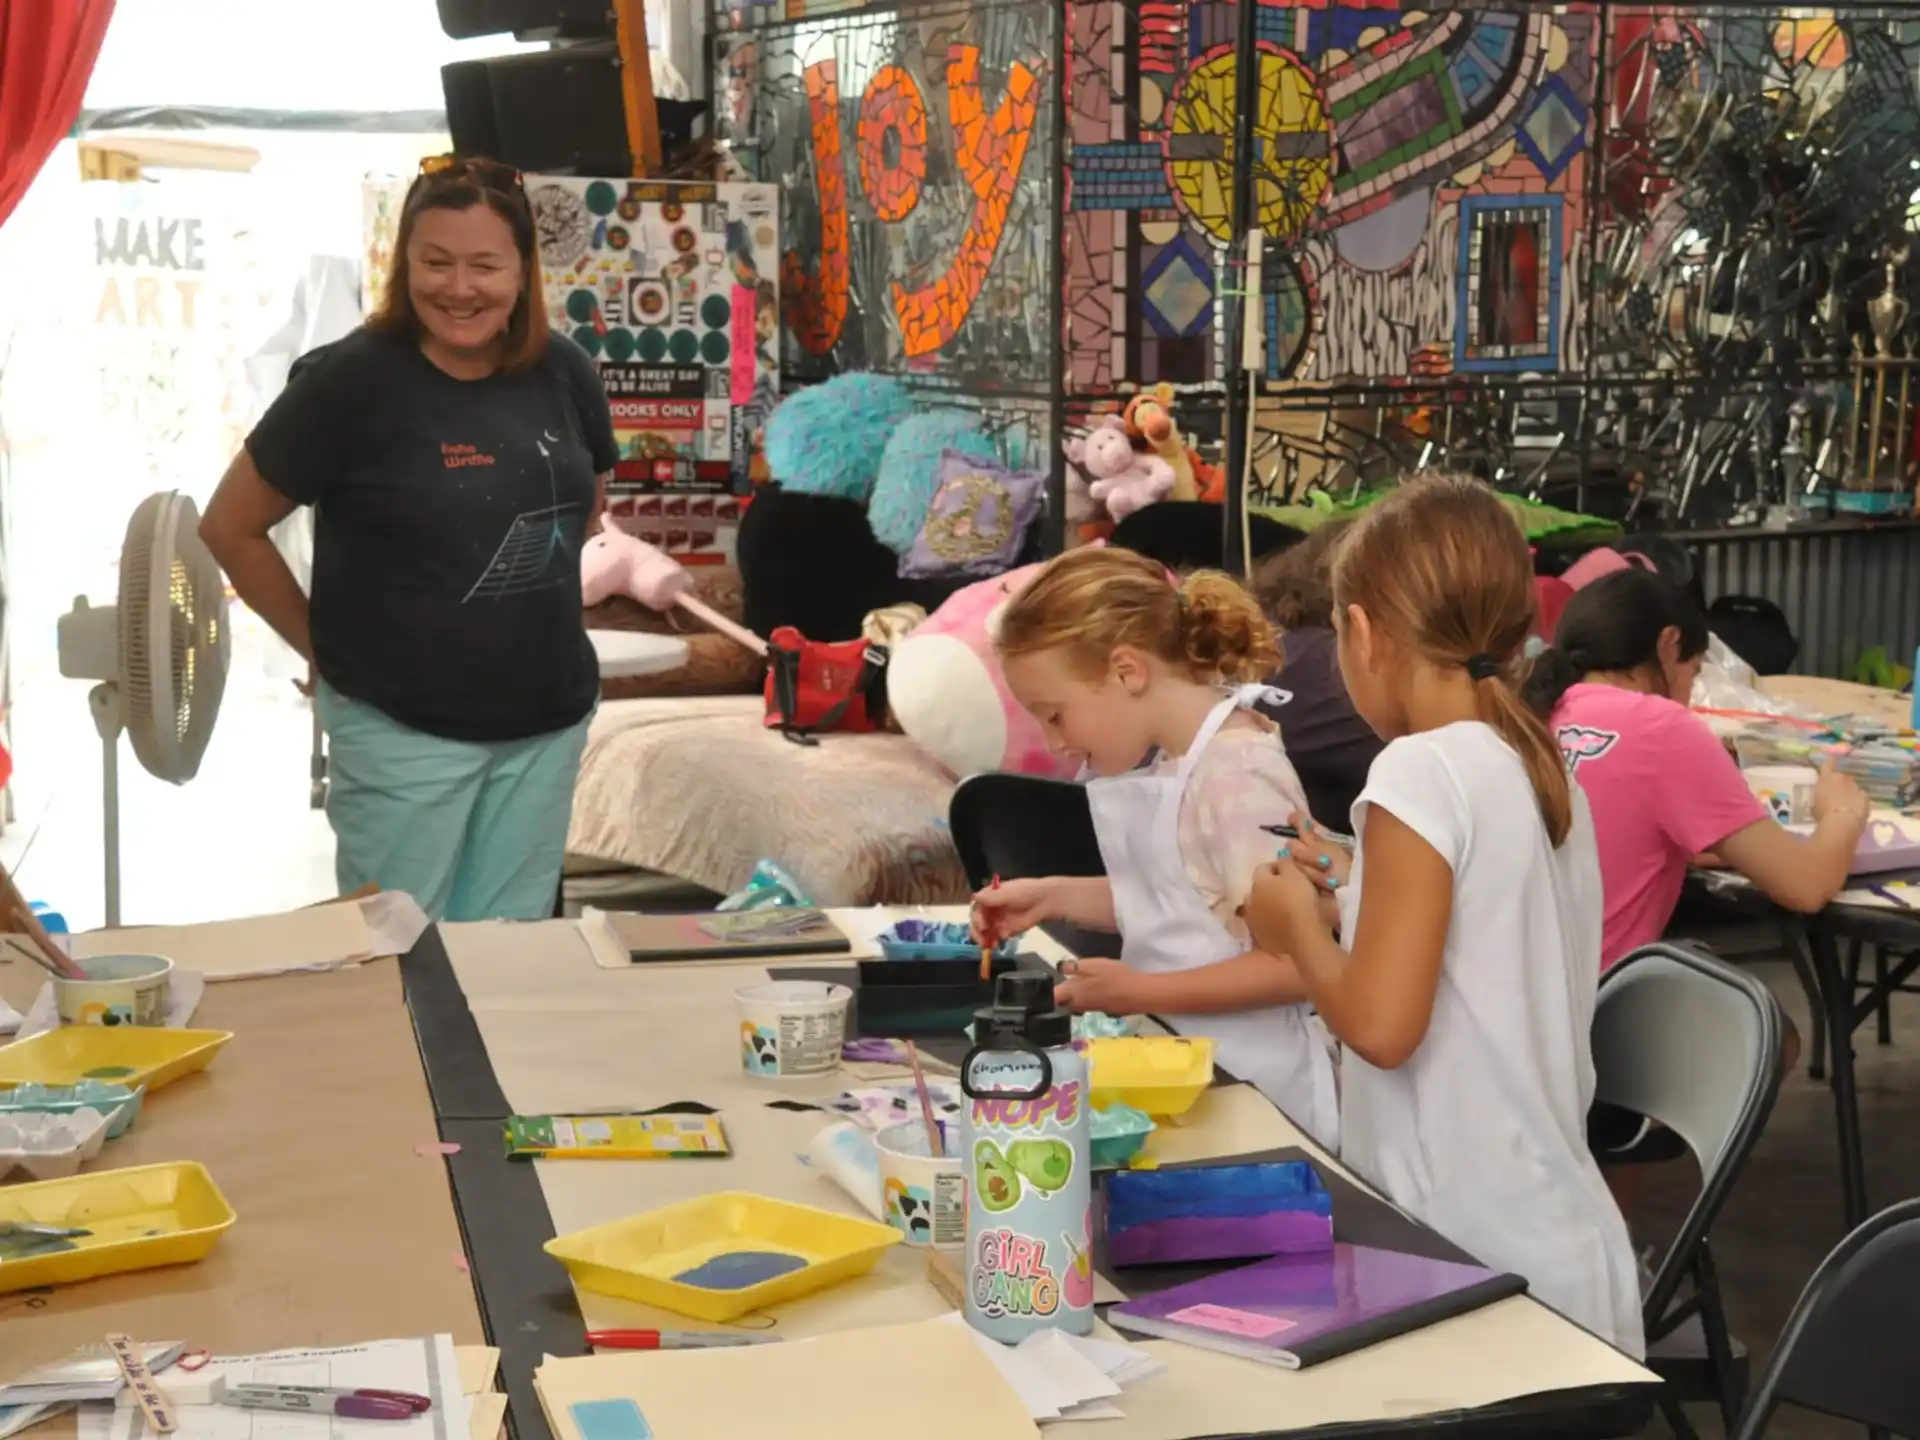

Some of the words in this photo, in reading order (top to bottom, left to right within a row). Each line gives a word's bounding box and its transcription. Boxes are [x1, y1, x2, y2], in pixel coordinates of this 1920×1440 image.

[94, 216, 204, 271] MAKE
[95, 276, 200, 332] ART
[605, 380, 619, 392] TO
[621, 380, 636, 392] BE
[639, 380, 671, 392] ALIVE
[628, 368, 637, 380] A
[640, 368, 675, 380] GREAT
[678, 369, 700, 381] DAY
[662, 403, 700, 417] ONLY
[972, 1080, 1080, 1127] NOPE
[972, 1267, 1060, 1315] GANG
